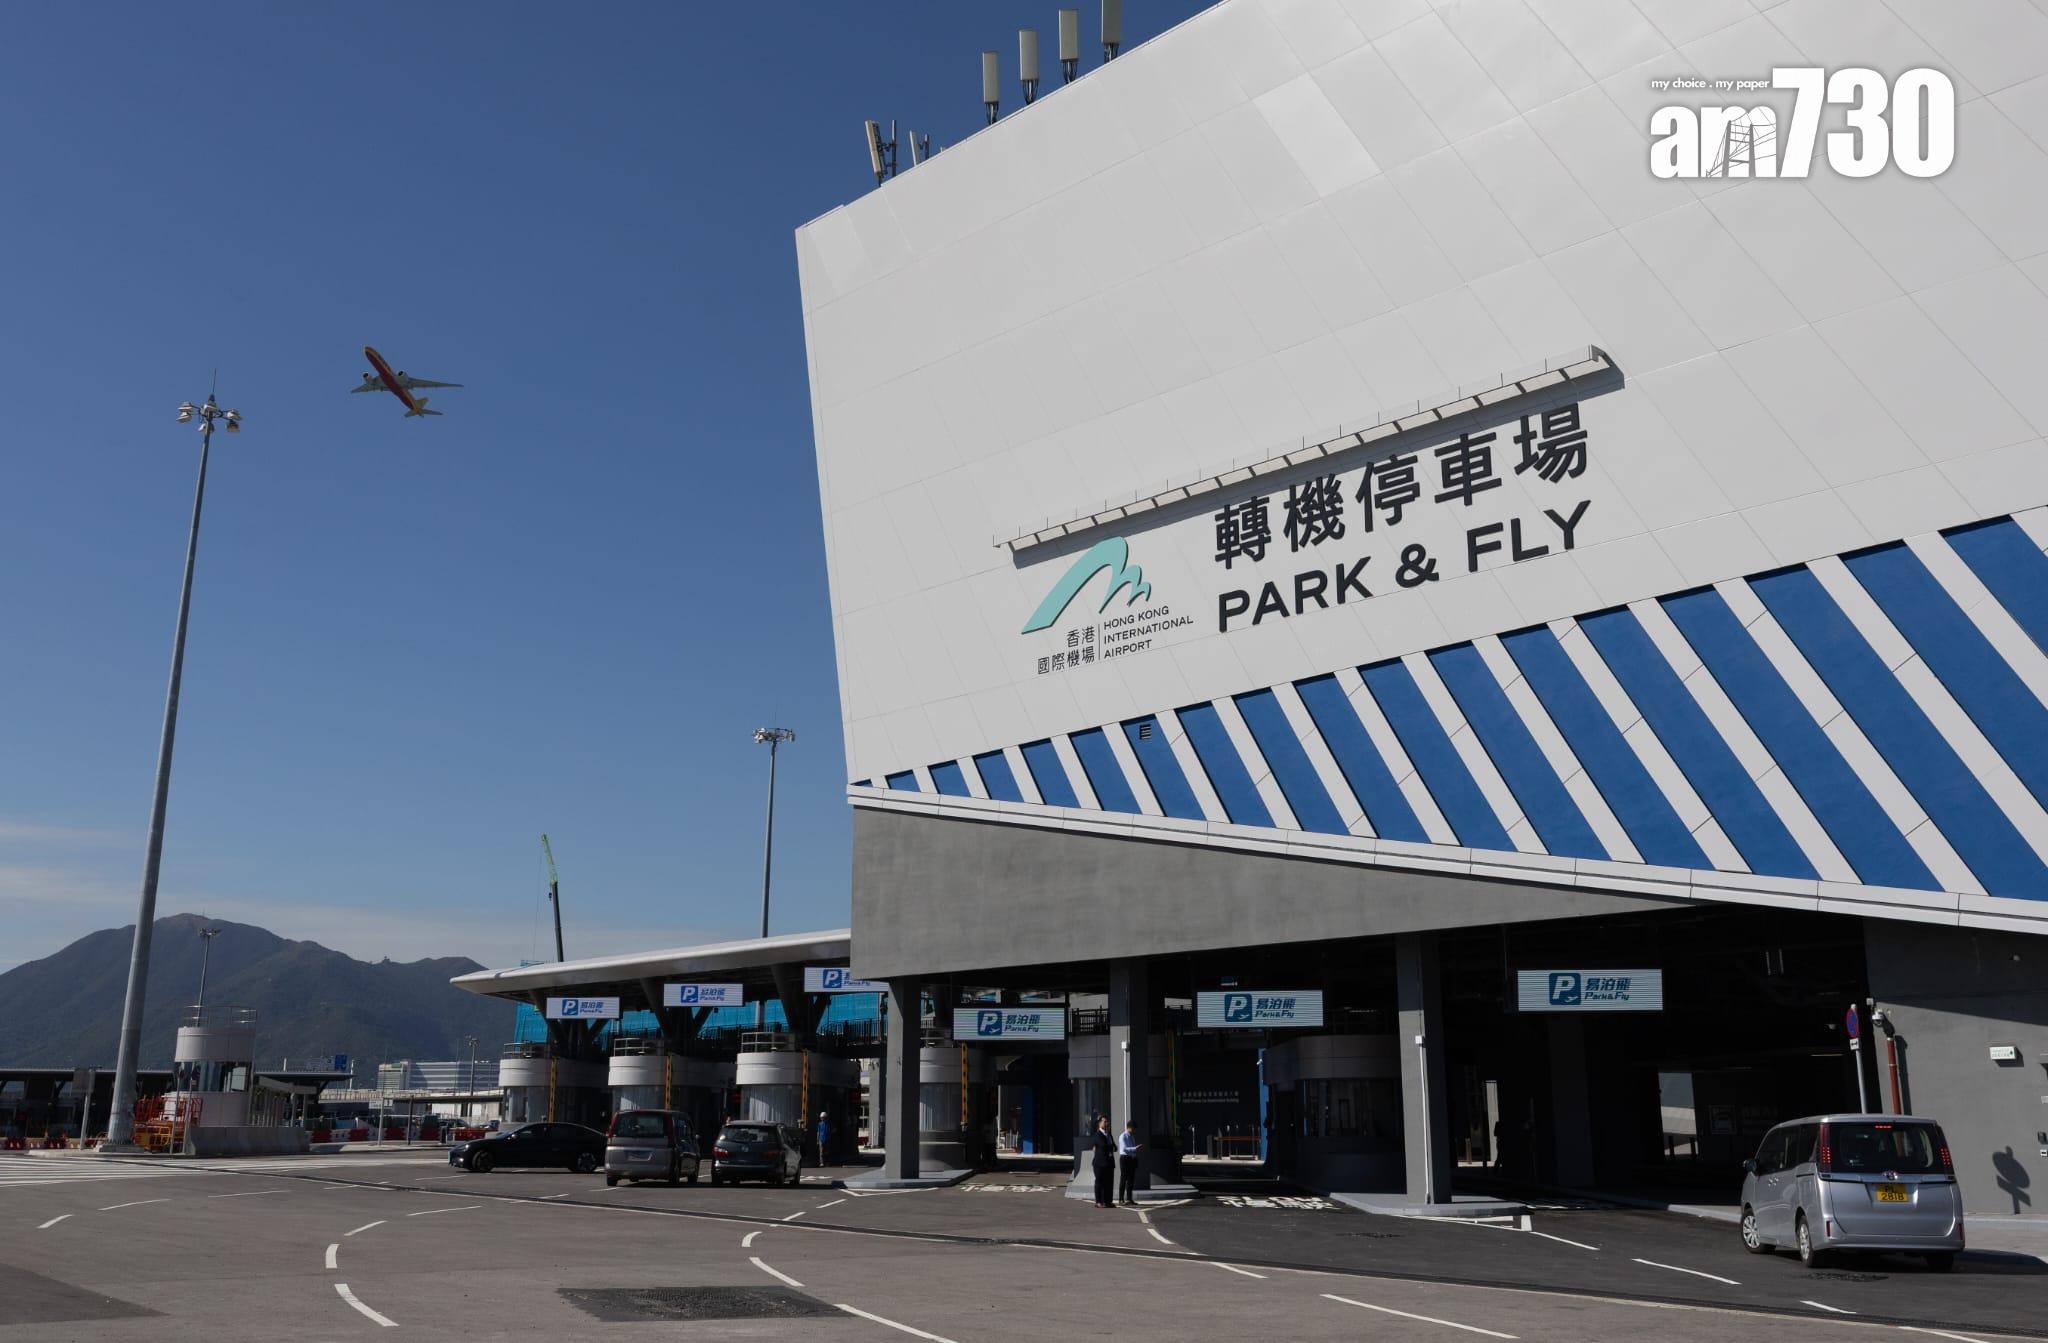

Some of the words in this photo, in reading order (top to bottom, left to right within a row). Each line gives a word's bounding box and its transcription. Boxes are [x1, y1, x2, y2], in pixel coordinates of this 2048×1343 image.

[1214, 402, 1588, 570] 轉機停車場
[1218, 556, 1373, 633] PARK
[1395, 543, 1439, 588] &
[1466, 500, 1591, 572] FLY
[1103, 615, 1135, 631] HONG
[1138, 606, 1169, 622] KONG
[1103, 615, 1194, 645] INTERNATIONAL
[1066, 625, 1095, 648] 香港
[1103, 639, 1152, 659] AIRPORT
[1038, 645, 1095, 675] 國際機場
